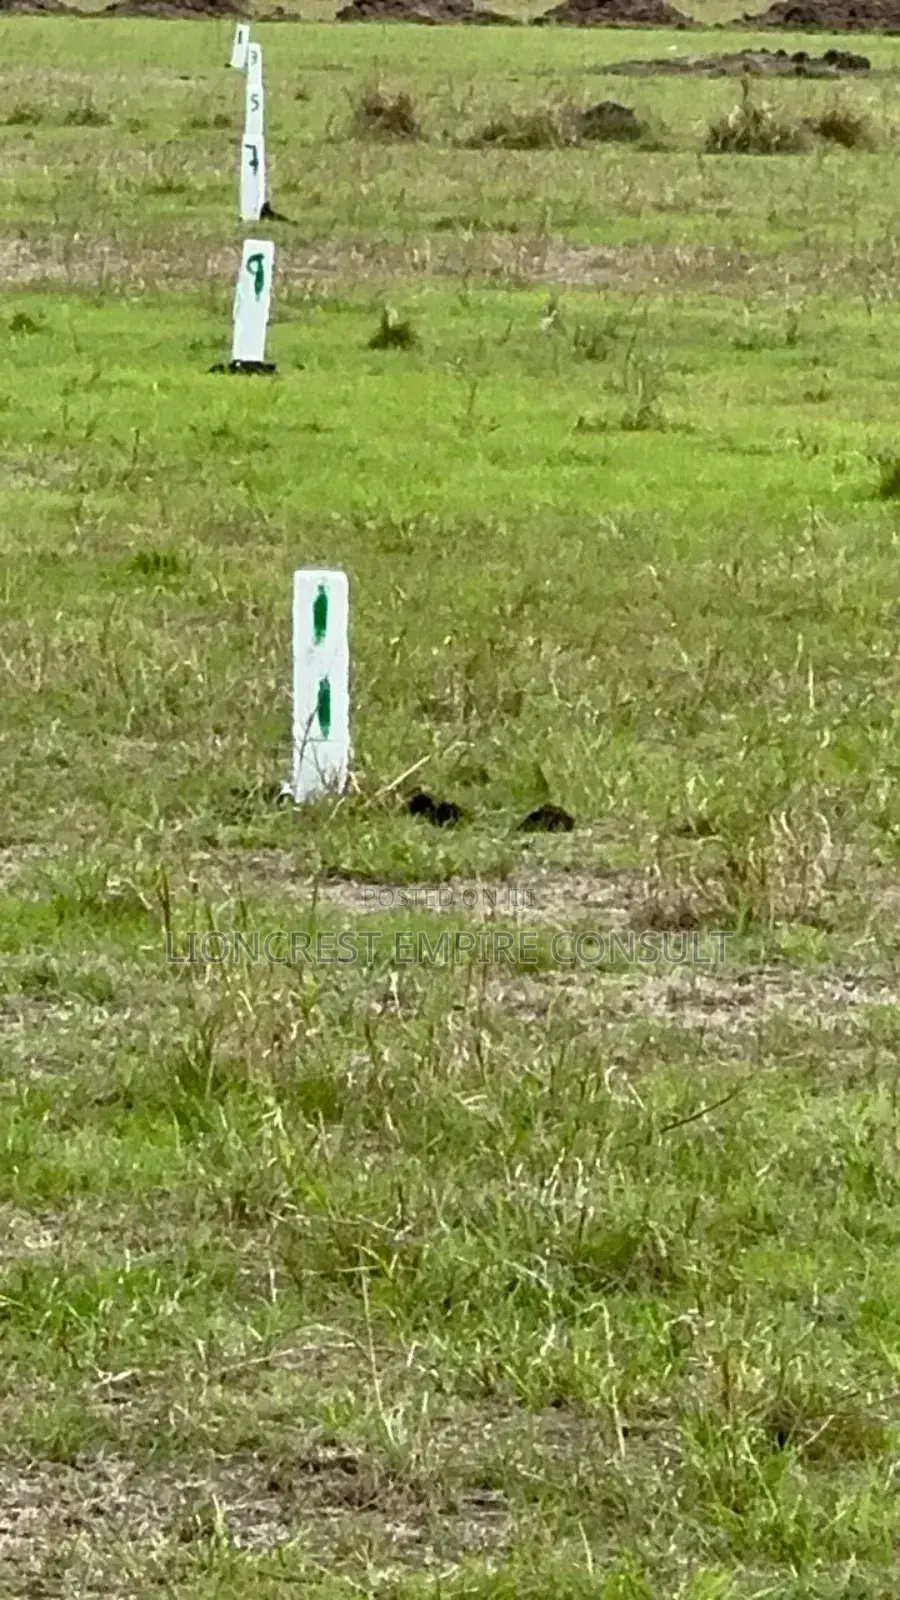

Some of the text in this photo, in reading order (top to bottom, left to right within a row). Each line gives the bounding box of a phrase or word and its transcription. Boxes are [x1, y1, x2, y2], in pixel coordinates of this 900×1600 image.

[237, 30, 243, 44] 1
[251, 94, 259, 112] 5
[245, 144, 259, 175] 7
[246, 253, 264, 300] 9
